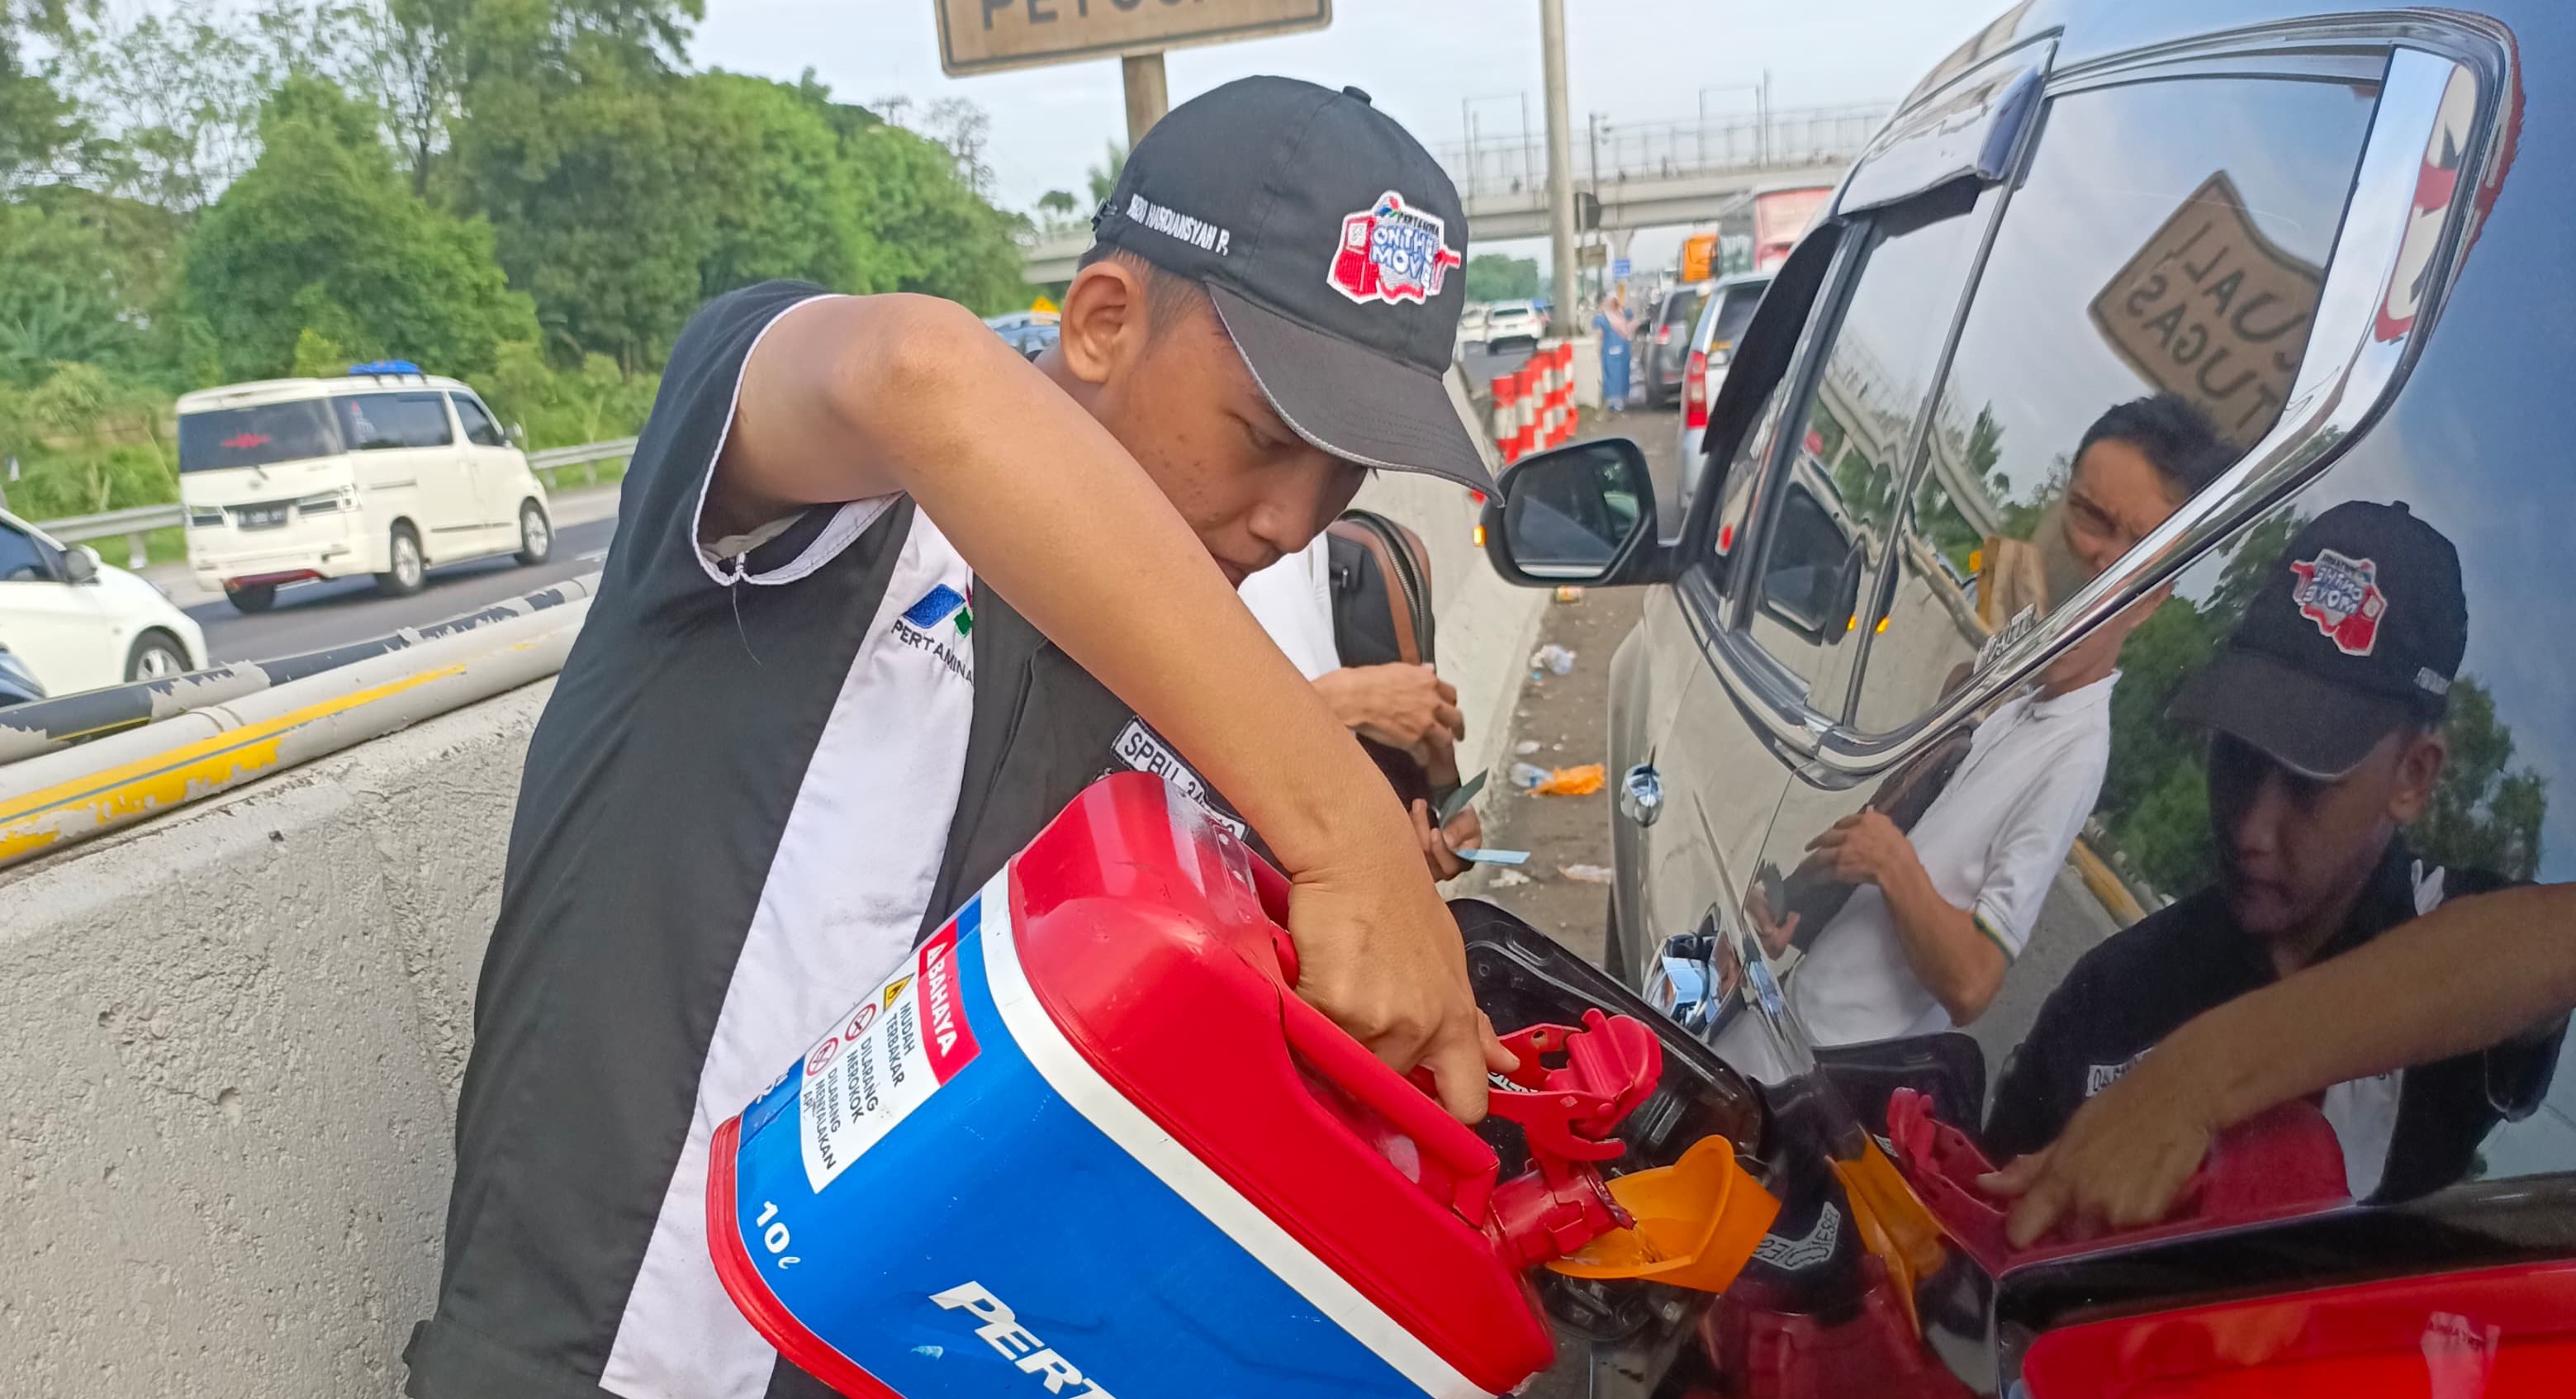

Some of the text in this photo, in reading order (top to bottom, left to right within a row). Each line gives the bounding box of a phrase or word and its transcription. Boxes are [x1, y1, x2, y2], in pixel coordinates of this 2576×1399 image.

[1371, 245, 1432, 291] MOVE
[890, 619, 974, 686] PERTAMINA
[900, 1001, 916, 1056] MUDAH
[928, 957, 958, 1058] BAHAYA
[847, 1049, 865, 1124] MEROKOK
[861, 1036, 879, 1112] DILARANG
[886, 1012, 905, 1088] TERBAKAR
[815, 1079, 837, 1170] MENYALAKAN
[828, 1067, 841, 1133] DILARANG
